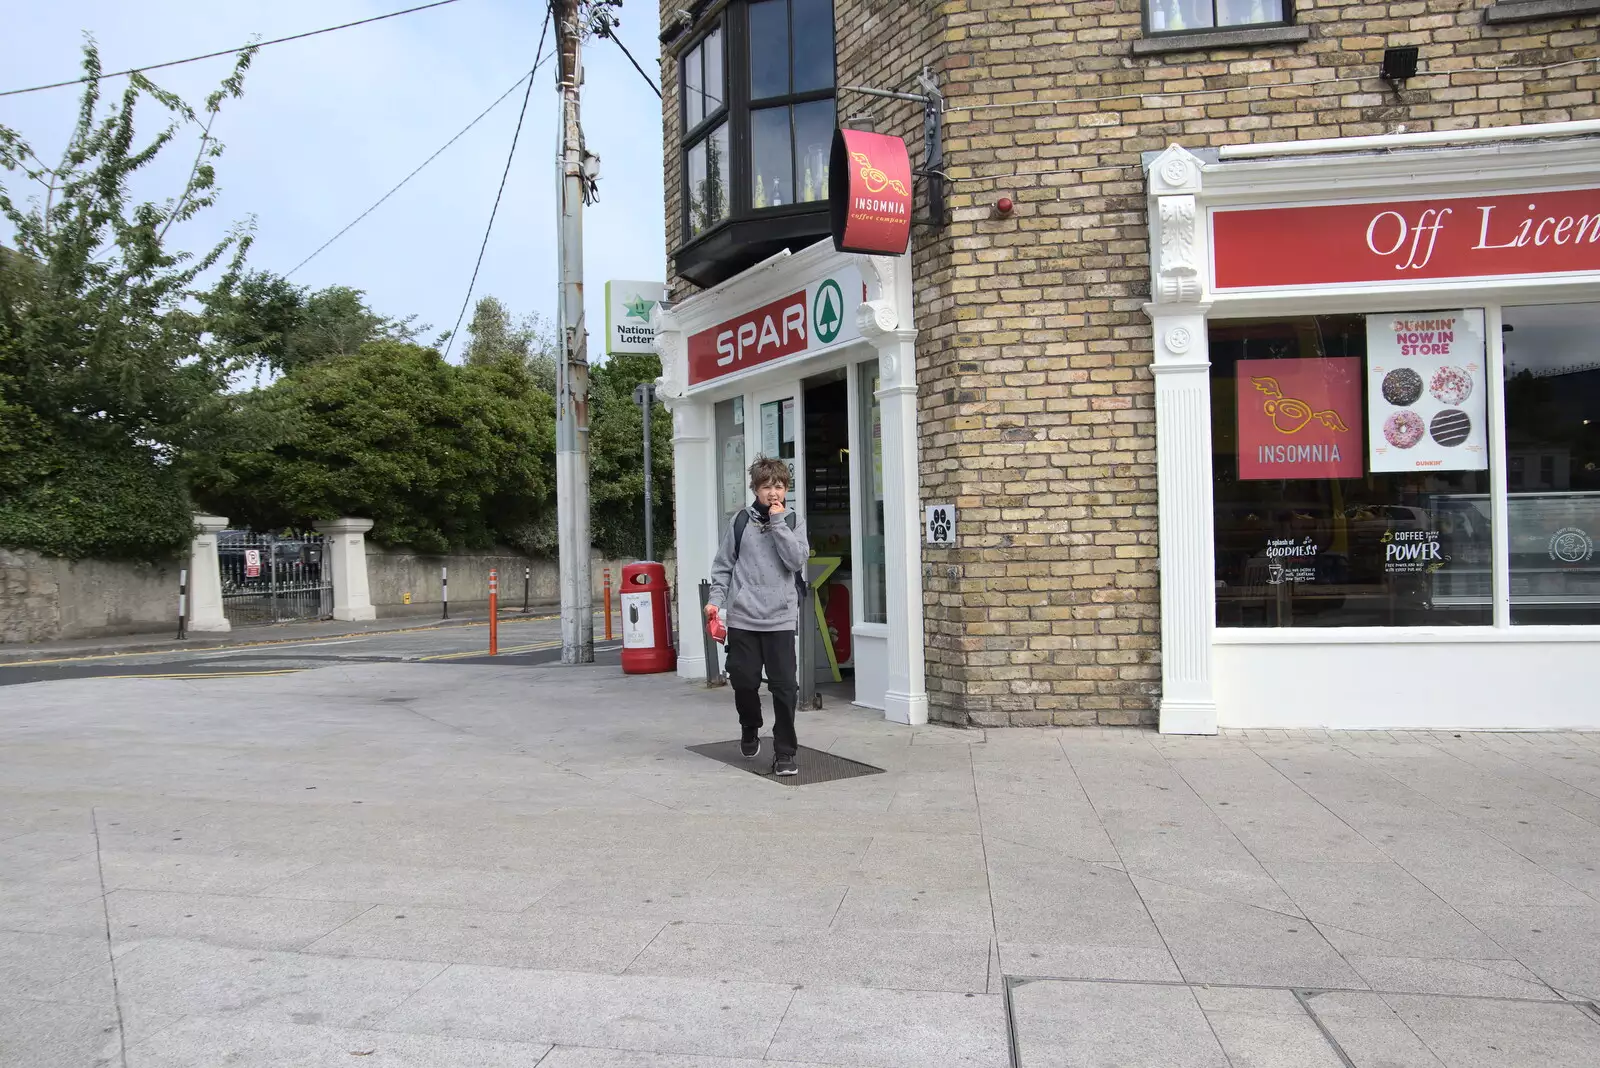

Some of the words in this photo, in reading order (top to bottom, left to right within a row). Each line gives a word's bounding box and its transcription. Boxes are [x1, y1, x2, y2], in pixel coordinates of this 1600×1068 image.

[855, 197, 905, 215] INSOMNIA
[851, 213, 874, 221] coffee
[876, 216, 908, 225] company
[1366, 207, 1453, 270] Off
[1471, 203, 1600, 250] Licen
[617, 325, 655, 335] Nationa
[1394, 318, 1456, 332] DUNKIN'
[716, 303, 805, 367] SPAR
[1396, 332, 1435, 344] NOW
[1438, 331, 1454, 343] IN
[1401, 343, 1450, 356] STORE
[1258, 444, 1341, 464] INSOMNIA
[1272, 539, 1288, 547] splash
[1288, 538, 1295, 546] of
[1394, 531, 1424, 541] COFFEE
[1266, 544, 1318, 559] GOODNESS
[1386, 541, 1442, 561] POWER
